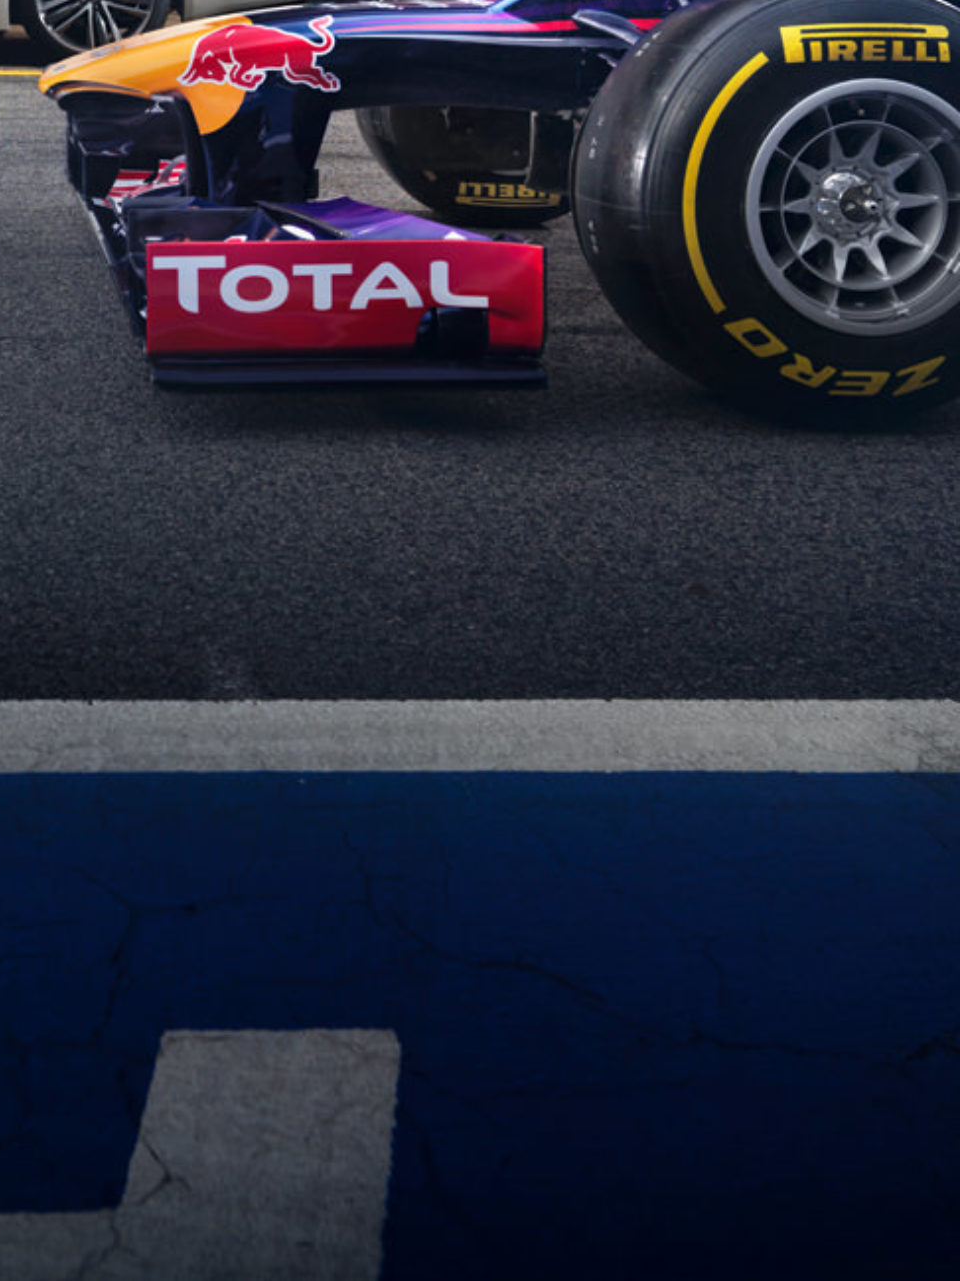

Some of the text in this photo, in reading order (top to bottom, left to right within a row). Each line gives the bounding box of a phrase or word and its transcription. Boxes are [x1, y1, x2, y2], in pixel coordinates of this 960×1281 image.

[780, 22, 951, 64] PIRELLI
[152, 255, 489, 314] TOTAL
[722, 317, 947, 396] ZERO
